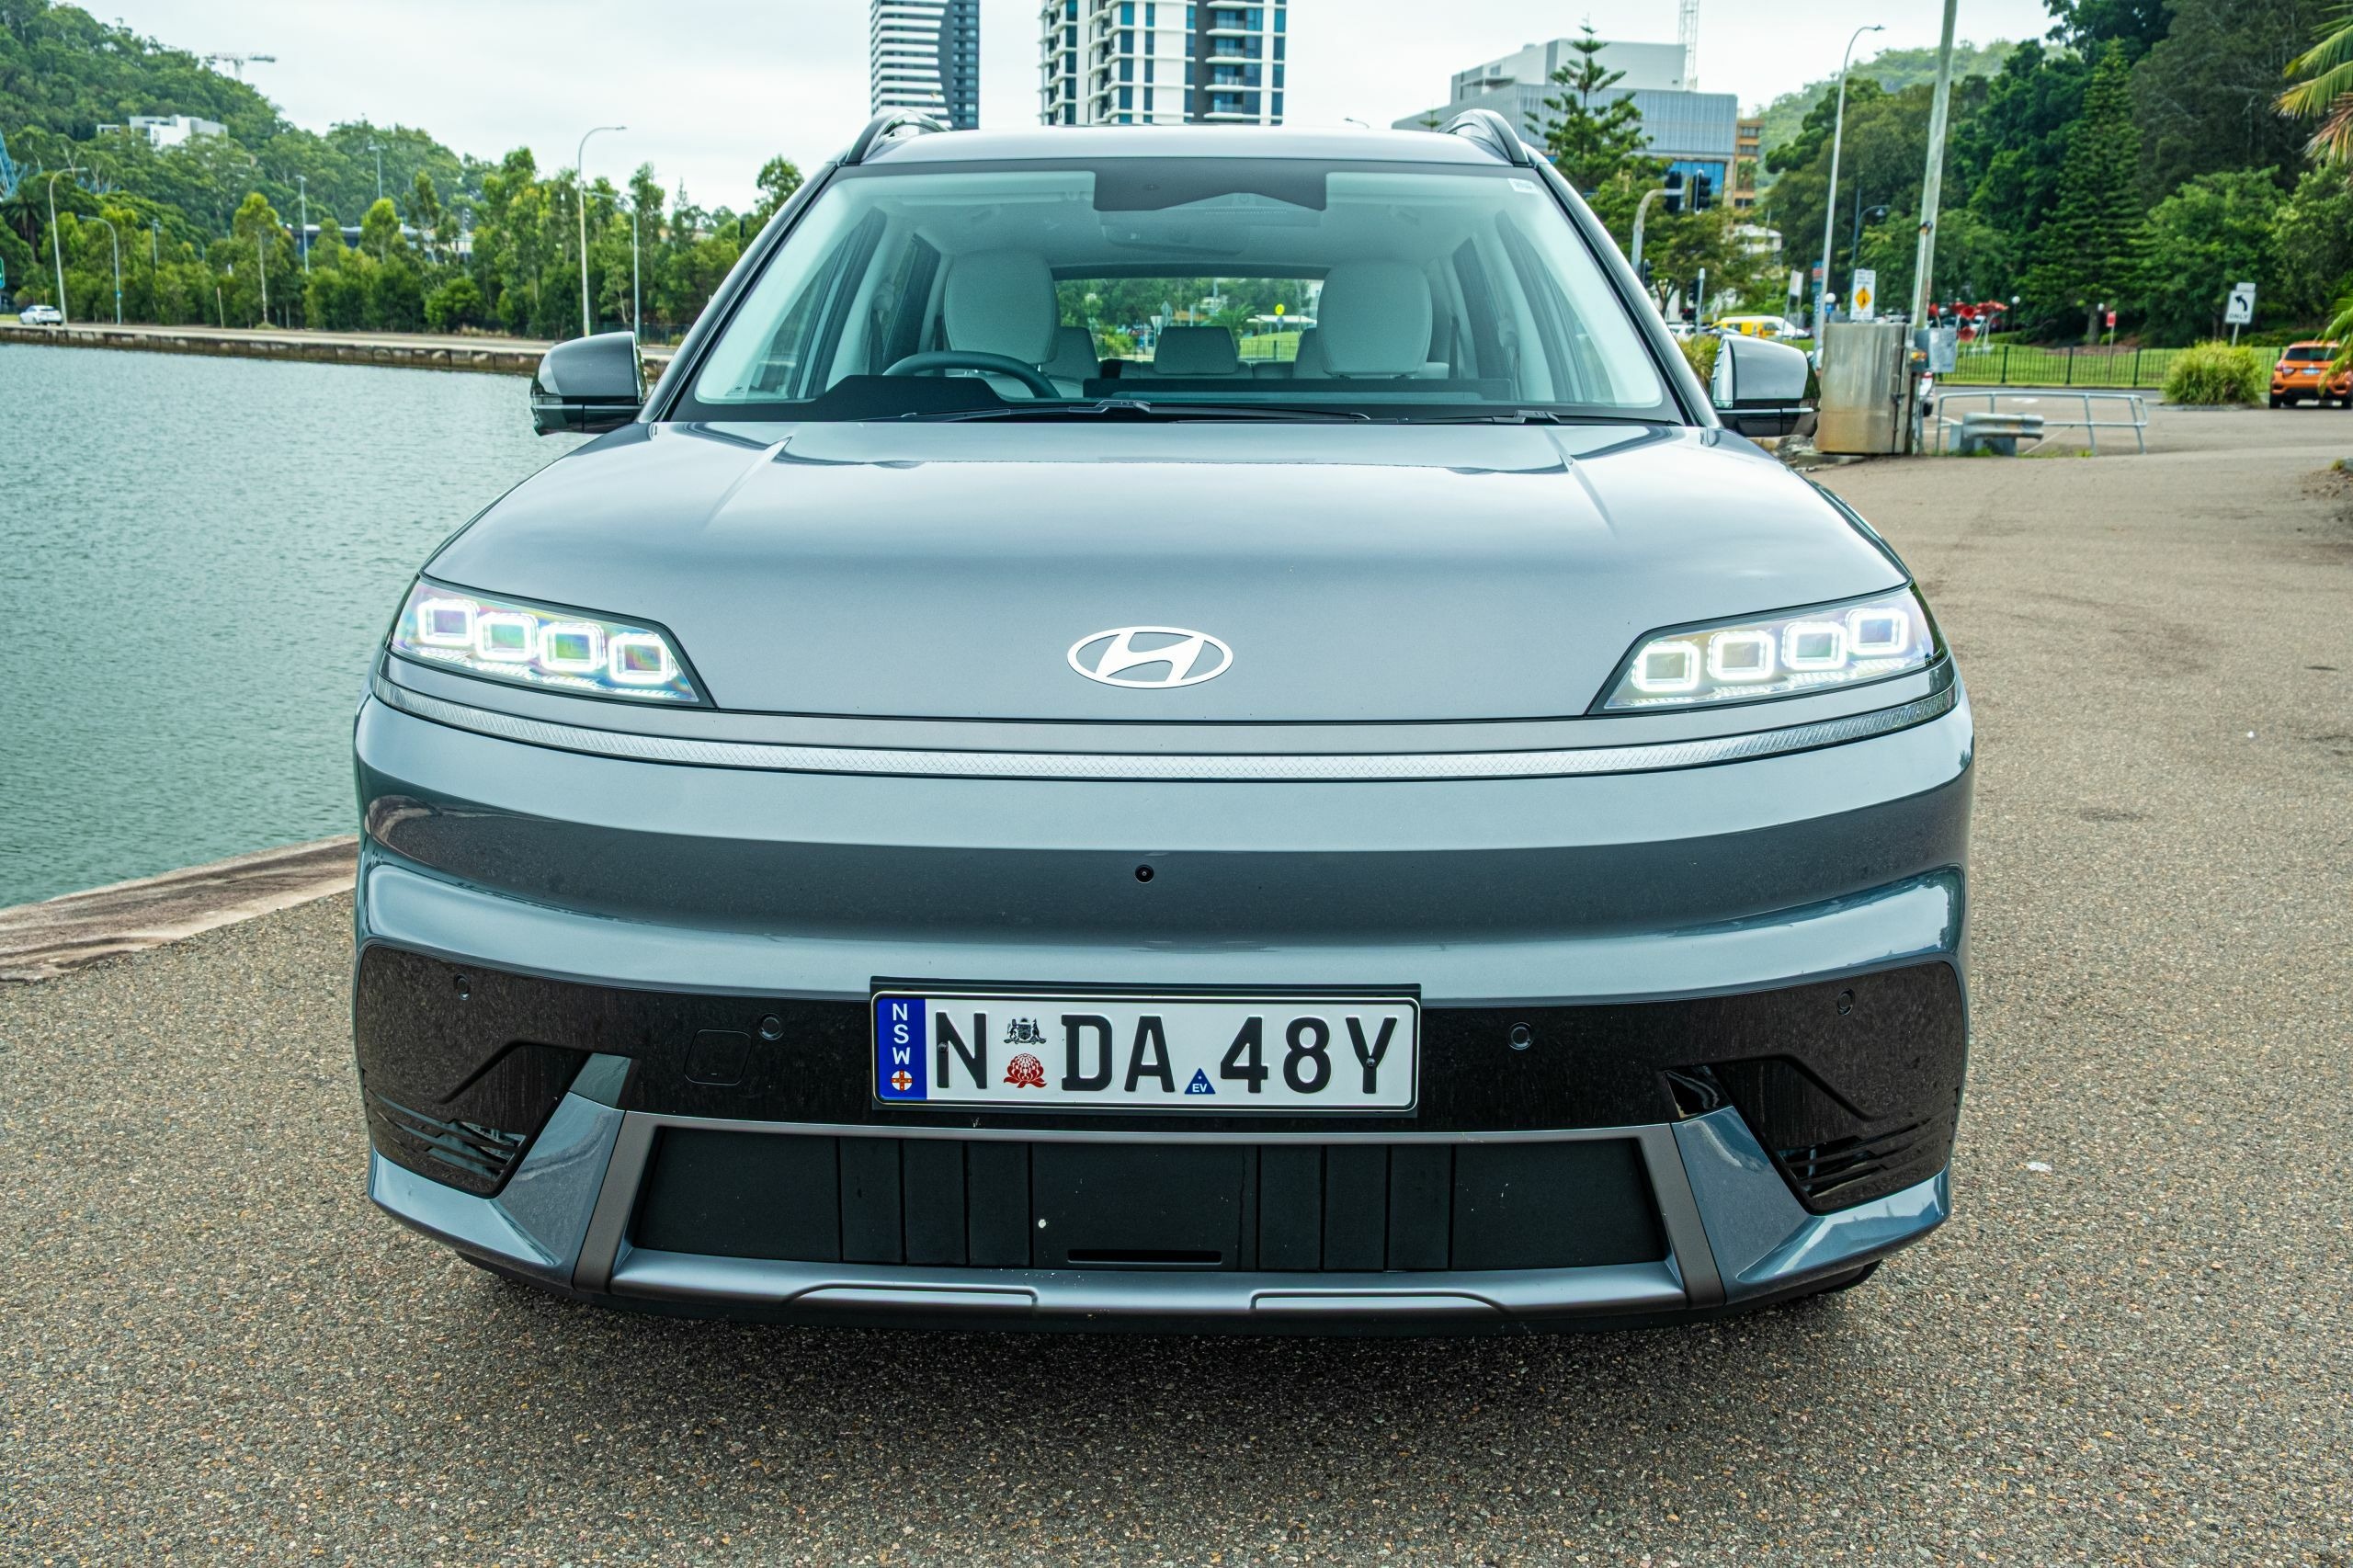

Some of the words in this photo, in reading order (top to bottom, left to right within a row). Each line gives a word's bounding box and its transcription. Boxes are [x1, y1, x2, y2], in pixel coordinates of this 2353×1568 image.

[892, 1003, 911, 1065] NSW
[1220, 1016, 1398, 1094] 48Y
[1192, 1083, 1207, 1093] EV
